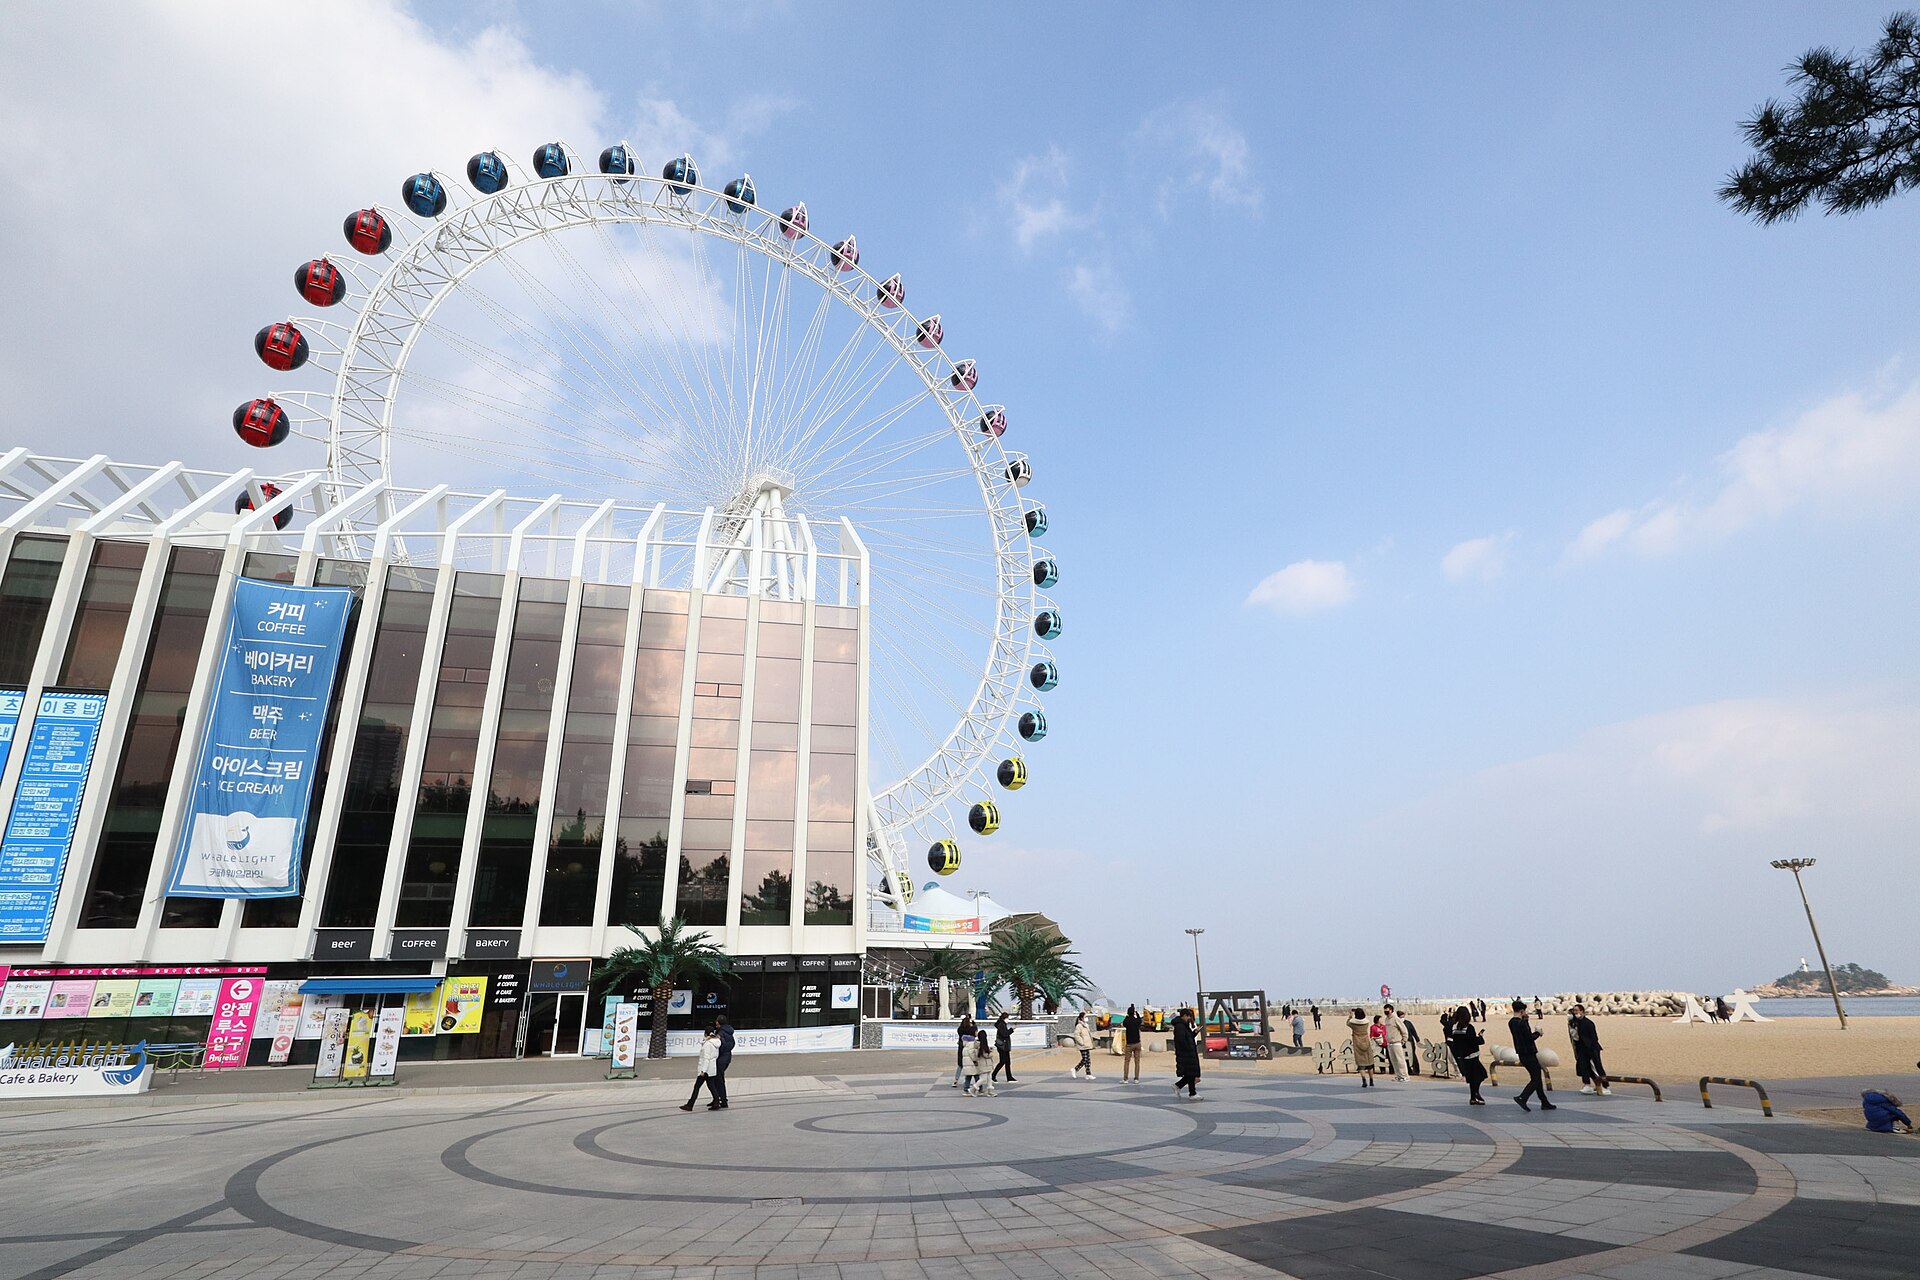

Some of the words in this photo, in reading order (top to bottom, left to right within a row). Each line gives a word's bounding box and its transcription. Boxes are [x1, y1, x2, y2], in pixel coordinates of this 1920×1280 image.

[267, 602, 305, 621] 커피
[257, 621, 306, 635] COFFEE
[244, 650, 314, 674] 베이커리
[251, 674, 297, 688] BAKERY
[253, 705, 283, 725] 맥주
[249, 728, 277, 740] BEER
[212, 757, 303, 780] 아이스크림
[237, 782, 283, 794] CREAM
[221, 1002, 252, 1017] 앙젤
[215, 1019, 247, 1034] 루스
[0, 1073, 24, 1084] Cafe
[38, 1073, 79, 1084] Bakery
